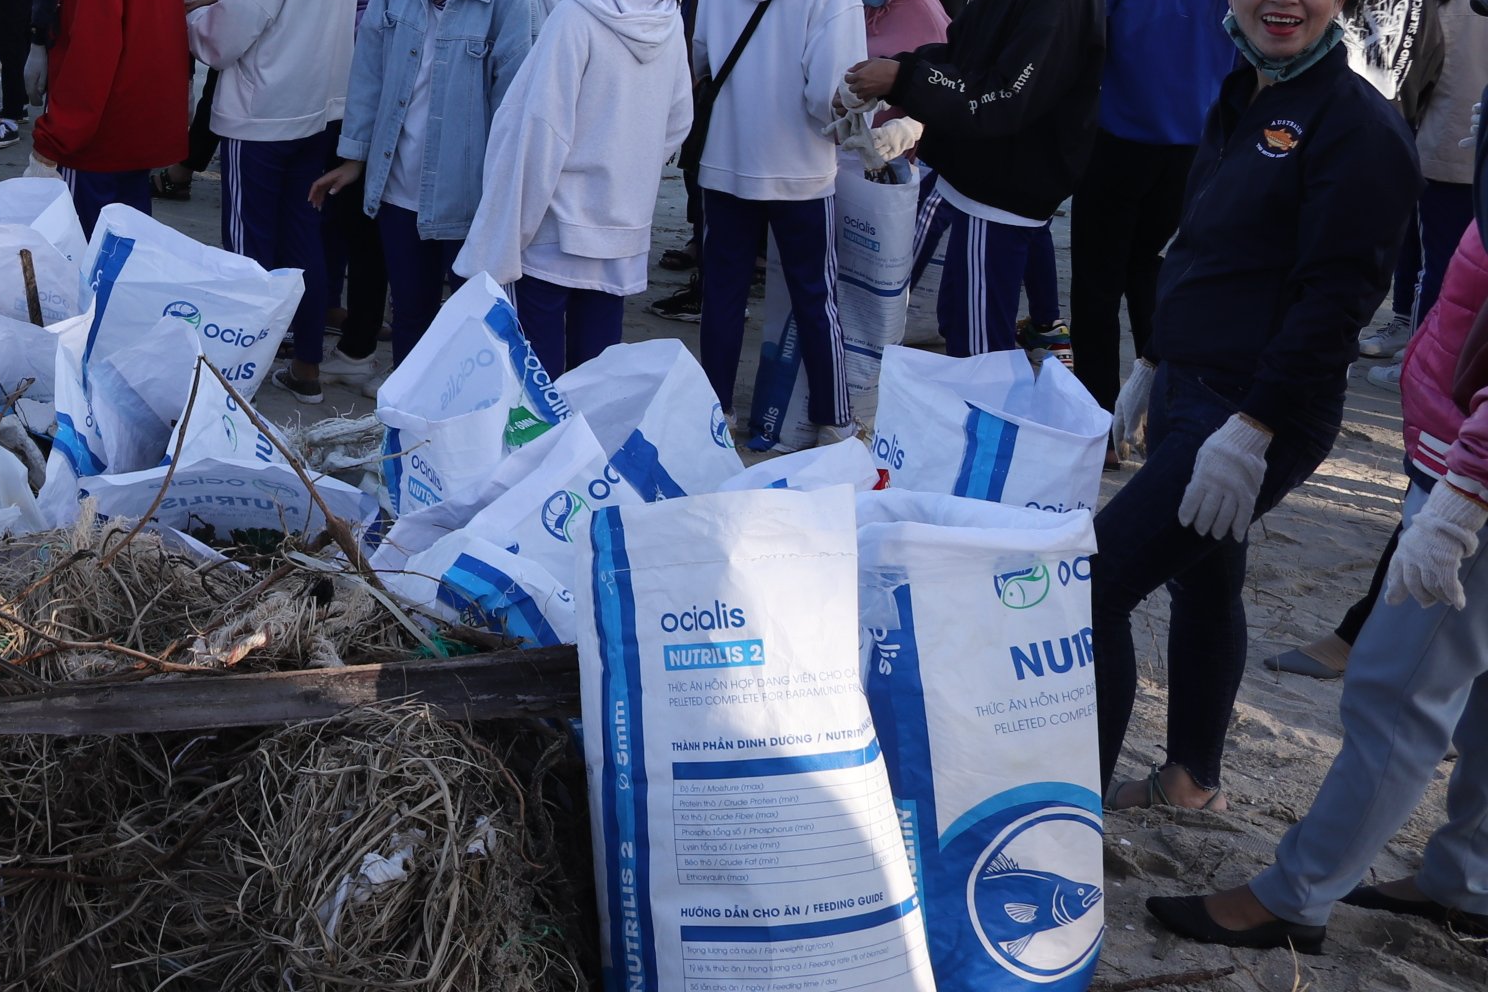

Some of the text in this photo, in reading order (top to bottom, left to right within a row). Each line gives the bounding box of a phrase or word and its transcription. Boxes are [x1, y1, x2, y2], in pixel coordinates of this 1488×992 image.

[1403, 34, 1414, 49] OF
[928, 67, 966, 93] Don't
[844, 215, 876, 236] ocialis
[524, 355, 574, 424] ocialis
[873, 429, 905, 470] ialis
[411, 454, 443, 492] ocialis
[661, 600, 746, 633] ocialis
[668, 644, 763, 667] NUTRILIS 2
[819, 668, 842, 683] CHO
[669, 685, 847, 708] PELLETED COMPLETE FOR BARAMUNDI
[974, 687, 1085, 718] THỨC ĂN HỖN HỢP
[994, 716, 1047, 736] PELLETED
[671, 733, 812, 752] THÀNH PHẦN DINH DƯỠNG
[707, 782, 764, 793] Moisture (max)
[680, 798, 703, 807] Protein
[724, 798, 748, 806] Crude
[750, 796, 777, 805] Protein
[779, 795, 799, 805] (min)
[709, 812, 734, 820] Crude
[735, 811, 754, 819] Fiber
[756, 810, 779, 820] (max)
[682, 828, 711, 838] Phospho
[713, 826, 731, 838] tổng
[749, 824, 793, 836] Phosphorus
[795, 823, 815, 834] (min)
[614, 700, 644, 992] NUTRILIS 2 5mm
[683, 843, 700, 853] Lysin
[700, 841, 718, 853] tổng
[734, 842, 758, 852] Lysine
[759, 840, 780, 850] (min)
[719, 857, 743, 866] Crude
[745, 857, 757, 865] Fat
[759, 856, 779, 865] (min)
[686, 873, 749, 882] Ethoxyquin (max)
[681, 891, 884, 919] HƯỚNG DẪN CHO ĂN FEEDING GUIDE
[764, 946, 778, 955] Fish
[779, 943, 803, 954] weight
[805, 940, 834, 952] (gr/con)
[808, 958, 836, 969] Feeding
[837, 956, 850, 965] rate
[772, 981, 802, 992] Feeding
[803, 979, 819, 988] time
[825, 977, 839, 988] day
